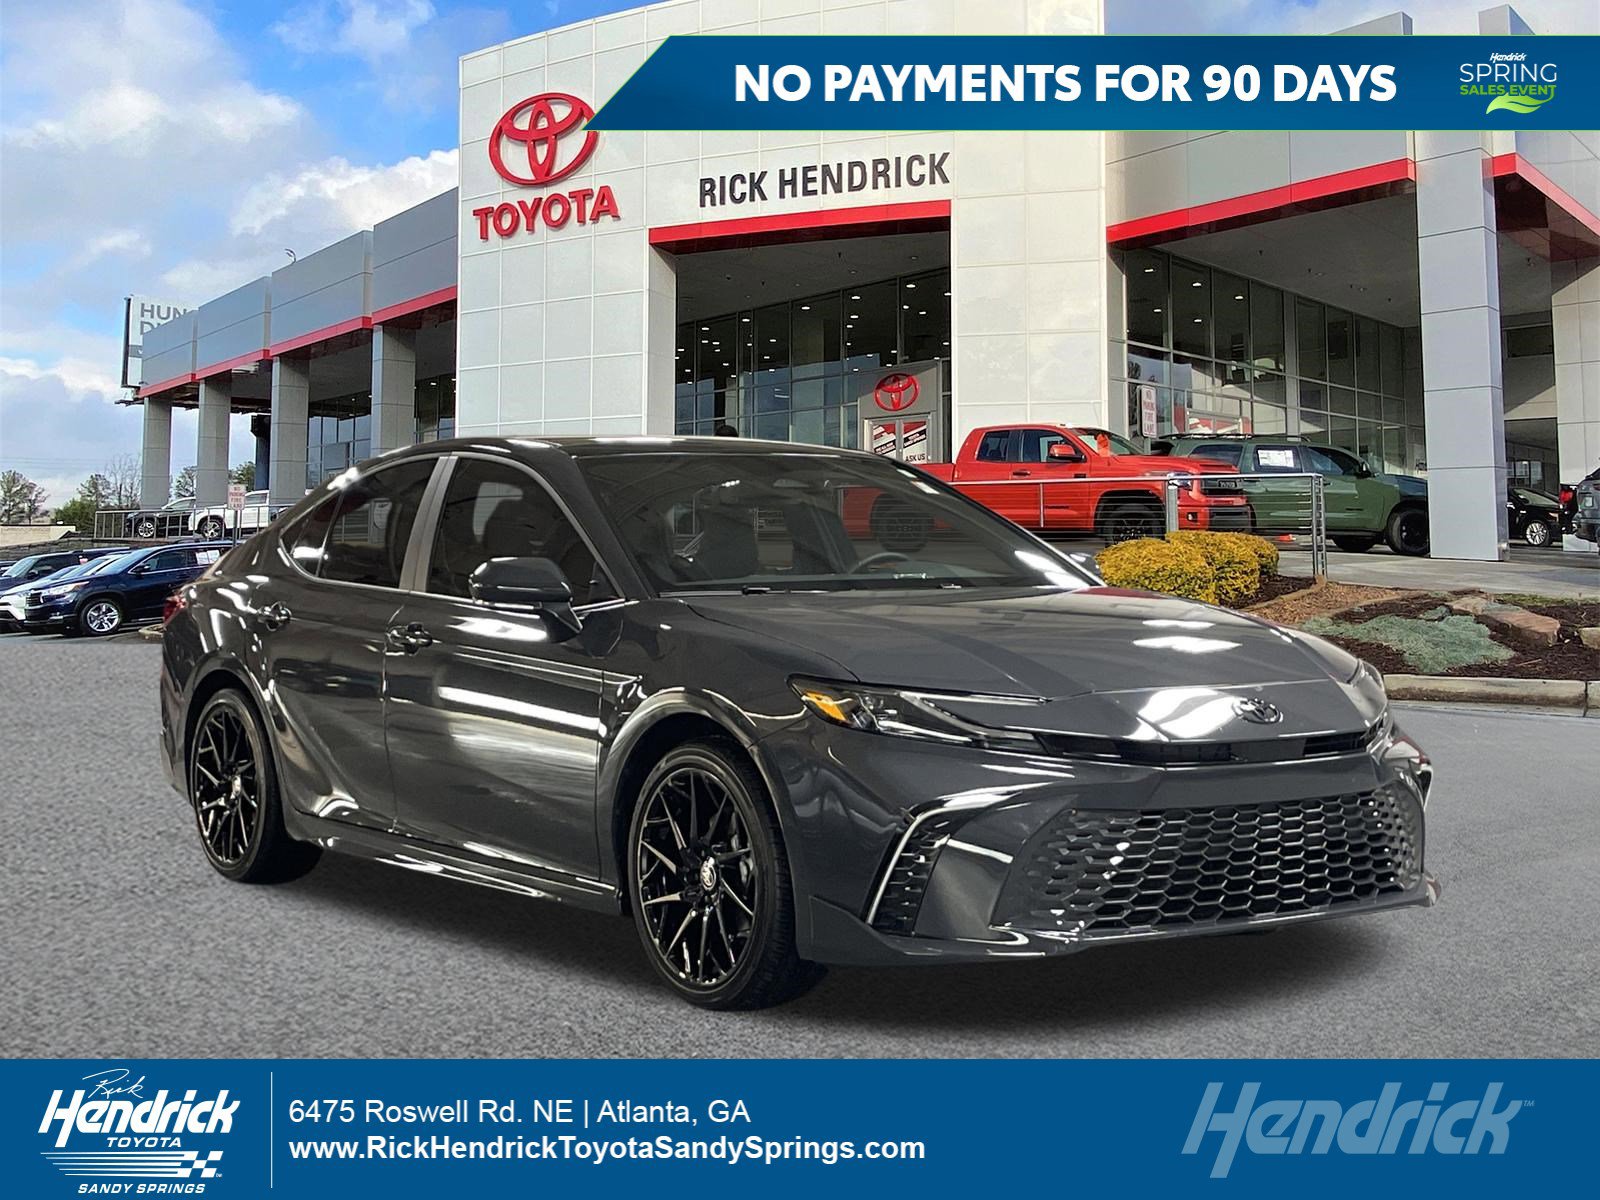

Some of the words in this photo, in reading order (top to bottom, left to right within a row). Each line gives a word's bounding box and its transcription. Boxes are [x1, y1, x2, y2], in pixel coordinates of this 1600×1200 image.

[699, 170, 768, 208] RICK
[778, 152, 951, 199] HENDRICK
[473, 185, 621, 241] TOYOTA
